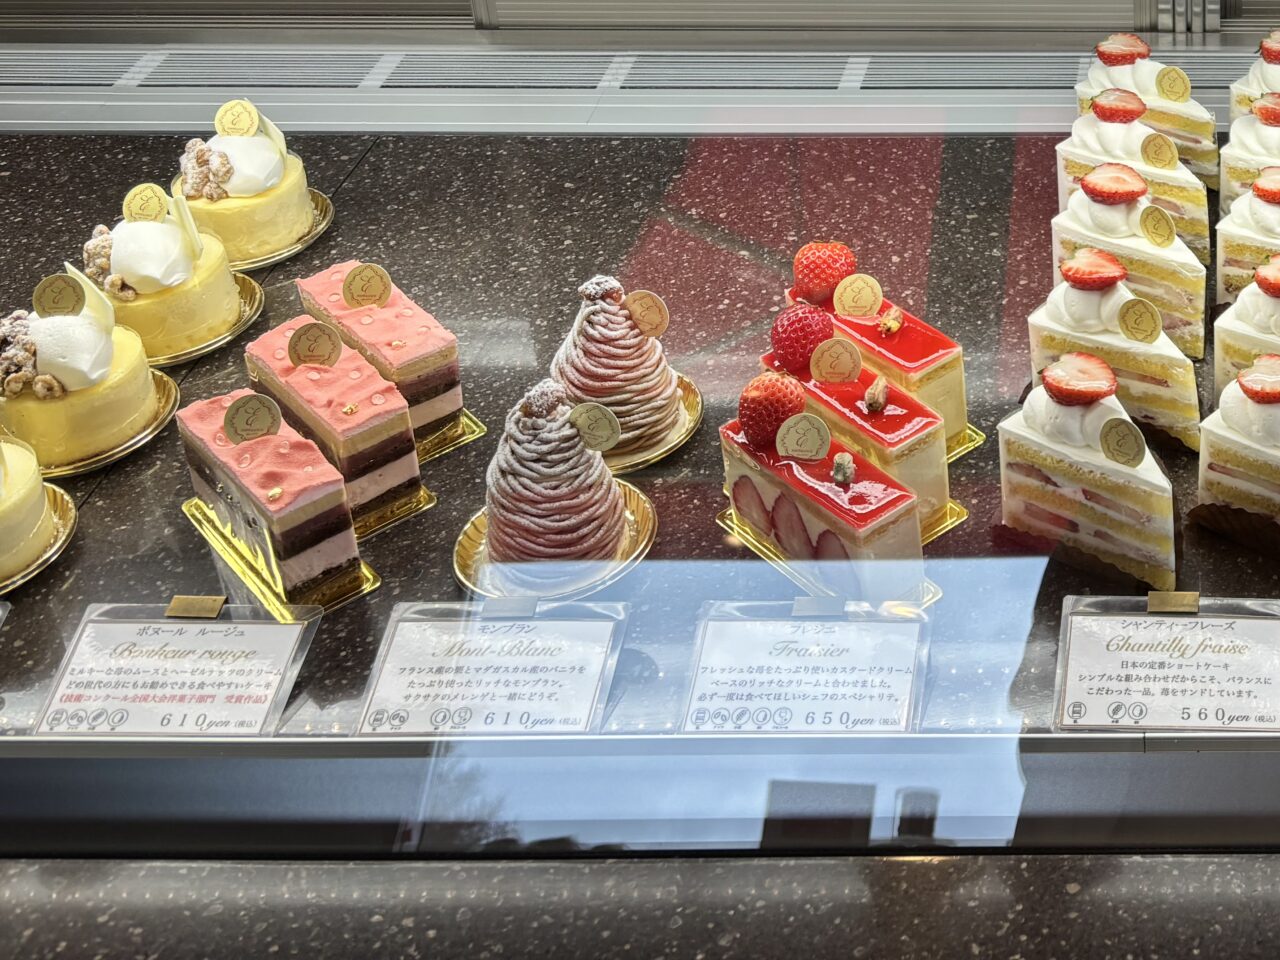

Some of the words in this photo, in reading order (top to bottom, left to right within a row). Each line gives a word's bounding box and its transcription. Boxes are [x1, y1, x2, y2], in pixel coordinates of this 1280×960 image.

[195, 626, 246, 637] ルージュ
[478, 623, 538, 634] モンブラン
[109, 641, 197, 660] Bonheur
[198, 648, 257, 665] rouge
[432, 639, 566, 657] Mont-Blanc
[768, 640, 850, 658] Fraisier
[1105, 635, 1191, 659] Chantilly
[1190, 637, 1250, 659] fraise
[1120, 661, 1230, 671] 日本の定番ショートケーキ
